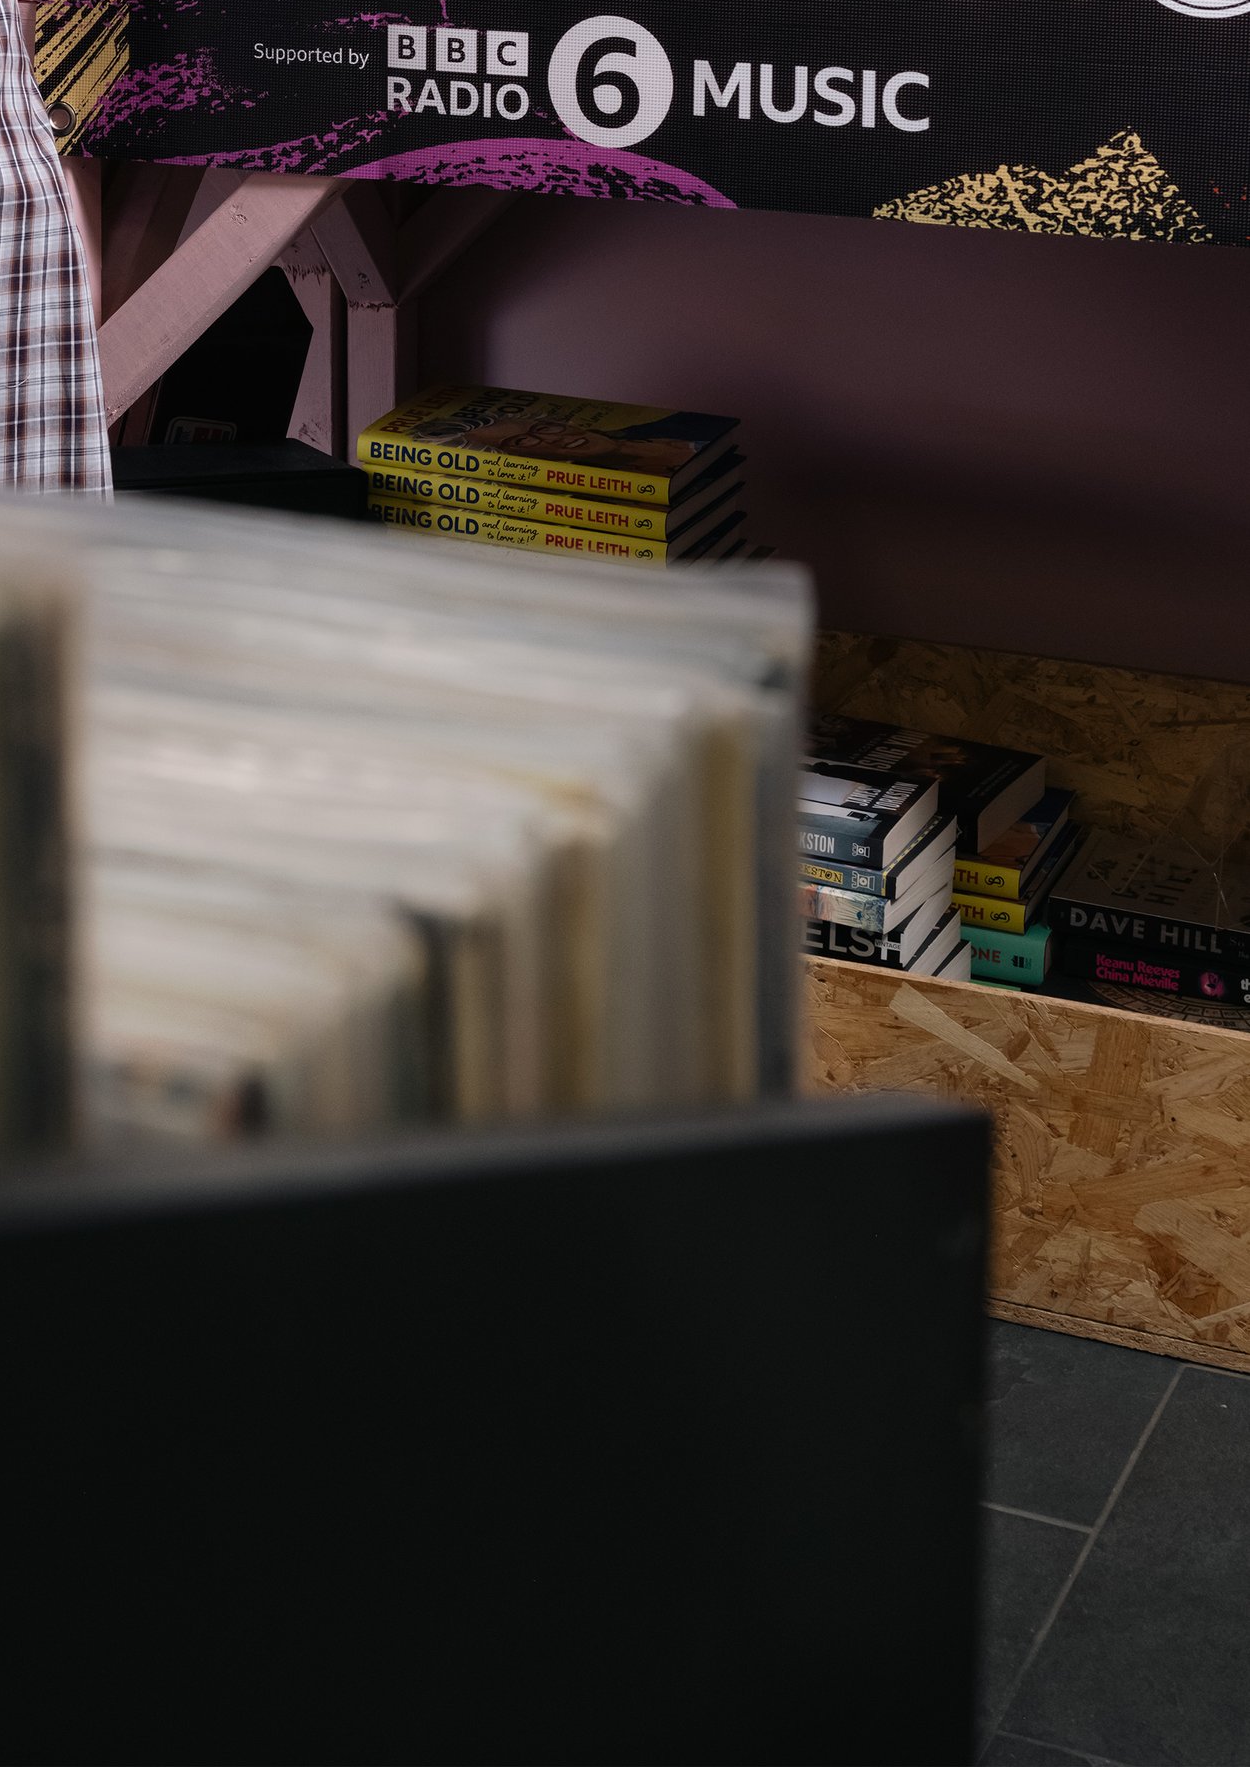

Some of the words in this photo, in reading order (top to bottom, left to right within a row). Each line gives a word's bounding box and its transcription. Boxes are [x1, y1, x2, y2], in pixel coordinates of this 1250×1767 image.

[253, 41, 344, 65] Supported
[348, 45, 370, 70] by
[572, 36, 642, 131] 6
[692, 59, 931, 133] MUSIC
[386, 75, 529, 121] RADIO
[369, 441, 432, 467] BEING
[437, 450, 480, 473] OLD
[482, 455, 502, 467] and
[503, 456, 541, 475] learning
[371, 471, 433, 498] BEING
[438, 483, 480, 505] OLD
[495, 468, 516, 482] love
[546, 469, 585, 488] PRUE
[589, 475, 632, 494] LEITH
[482, 488, 502, 500] and
[502, 489, 540, 509] learning
[495, 501, 516, 514] love
[371, 502, 432, 530] BEING
[437, 514, 480, 536] OLD
[545, 502, 584, 521] PRUE
[587, 508, 629, 528] LEITH
[482, 520, 502, 531] and
[502, 521, 539, 539] learning
[495, 532, 515, 545] love
[545, 533, 584, 551] PRUE
[587, 538, 630, 559] LEITH
[1069, 906, 1147, 940] DAVE
[1159, 922, 1222, 954] HILL
[1095, 951, 1135, 972] Keanu
[1137, 959, 1182, 981] Reeves
[1095, 965, 1131, 982] China
